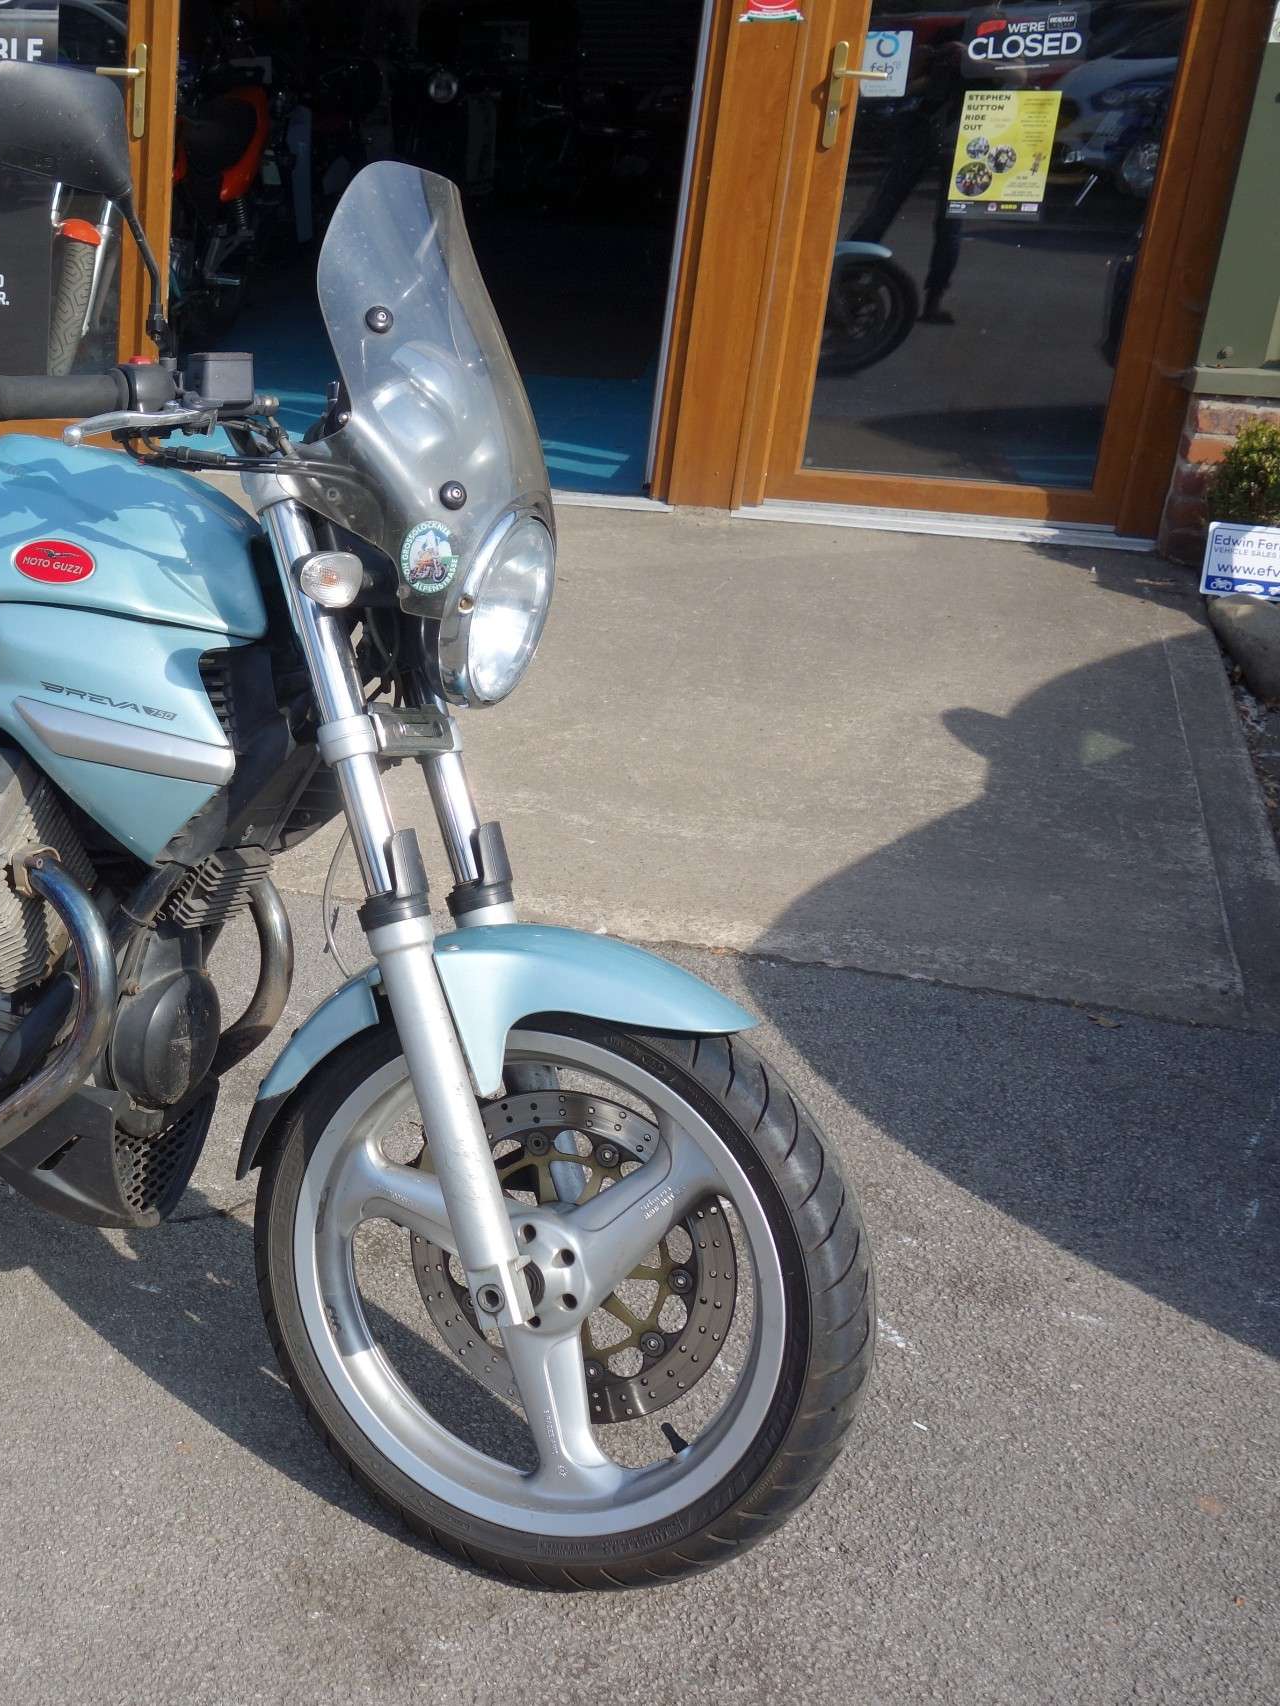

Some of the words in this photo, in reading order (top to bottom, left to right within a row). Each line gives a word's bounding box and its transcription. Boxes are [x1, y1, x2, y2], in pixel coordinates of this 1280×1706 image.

[1007, 21, 1046, 33] WE'RE
[967, 31, 1082, 60] CLOSED
[1214, 534, 1254, 549] Edwin
[1214, 546, 1249, 556] VEHICLE
[1251, 550, 1277, 559] SALES
[22, 556, 51, 568] MOTO
[52, 561, 83, 575] GUZZI
[40, 680, 141, 713] BREVA
